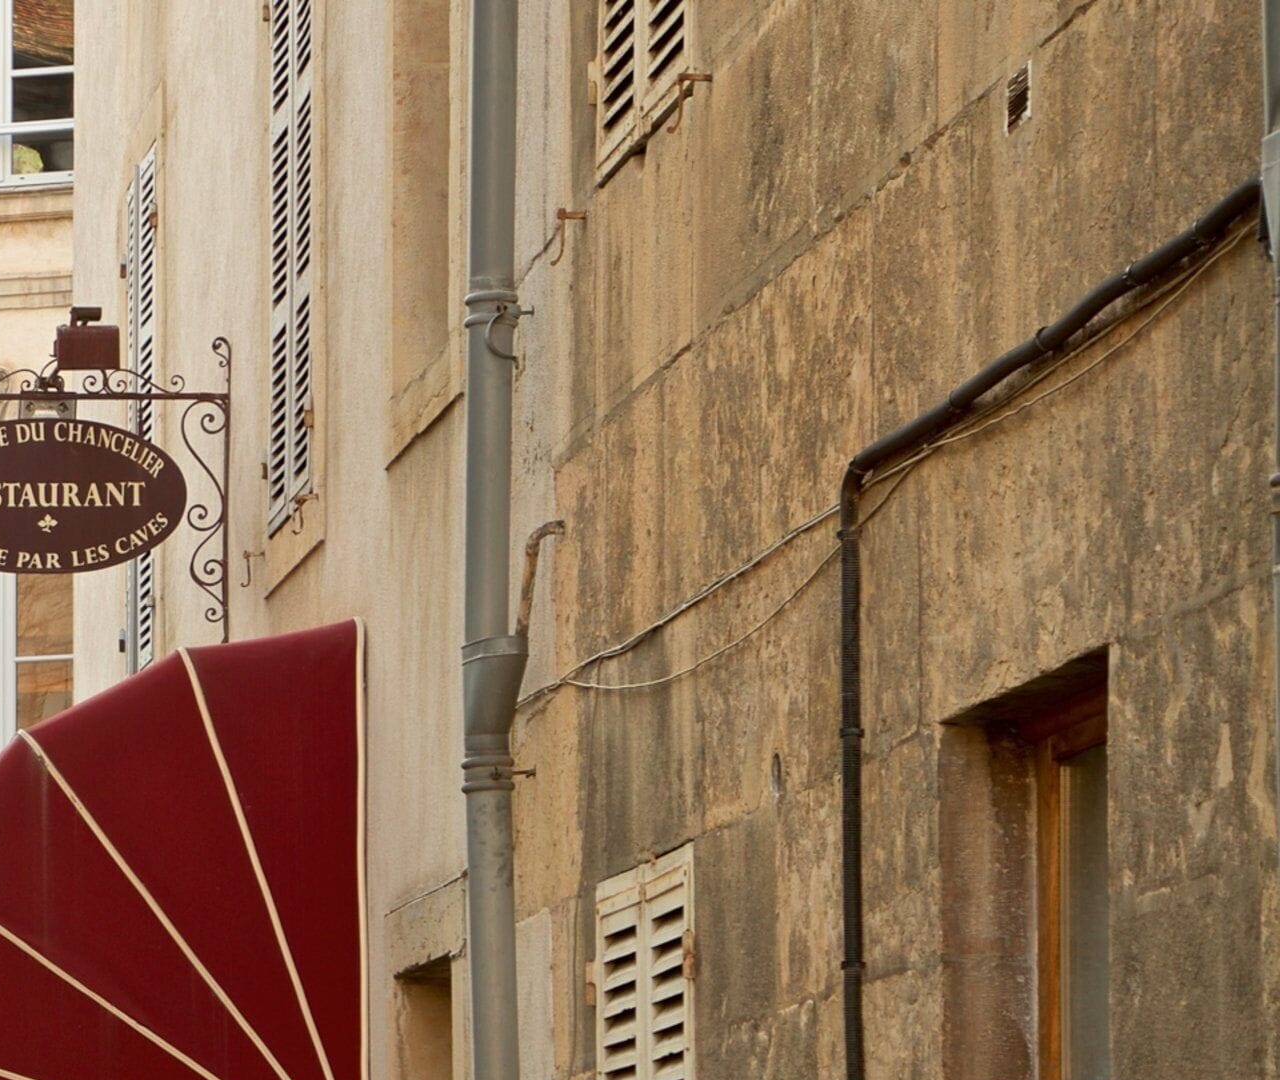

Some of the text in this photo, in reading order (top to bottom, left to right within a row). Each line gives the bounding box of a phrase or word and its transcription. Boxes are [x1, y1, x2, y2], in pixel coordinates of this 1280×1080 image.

[15, 422, 45, 443] DU
[53, 420, 166, 480] CHANCELIER
[17, 549, 61, 569] PAR
[71, 544, 110, 568] LES
[114, 511, 169, 556] CAVES
